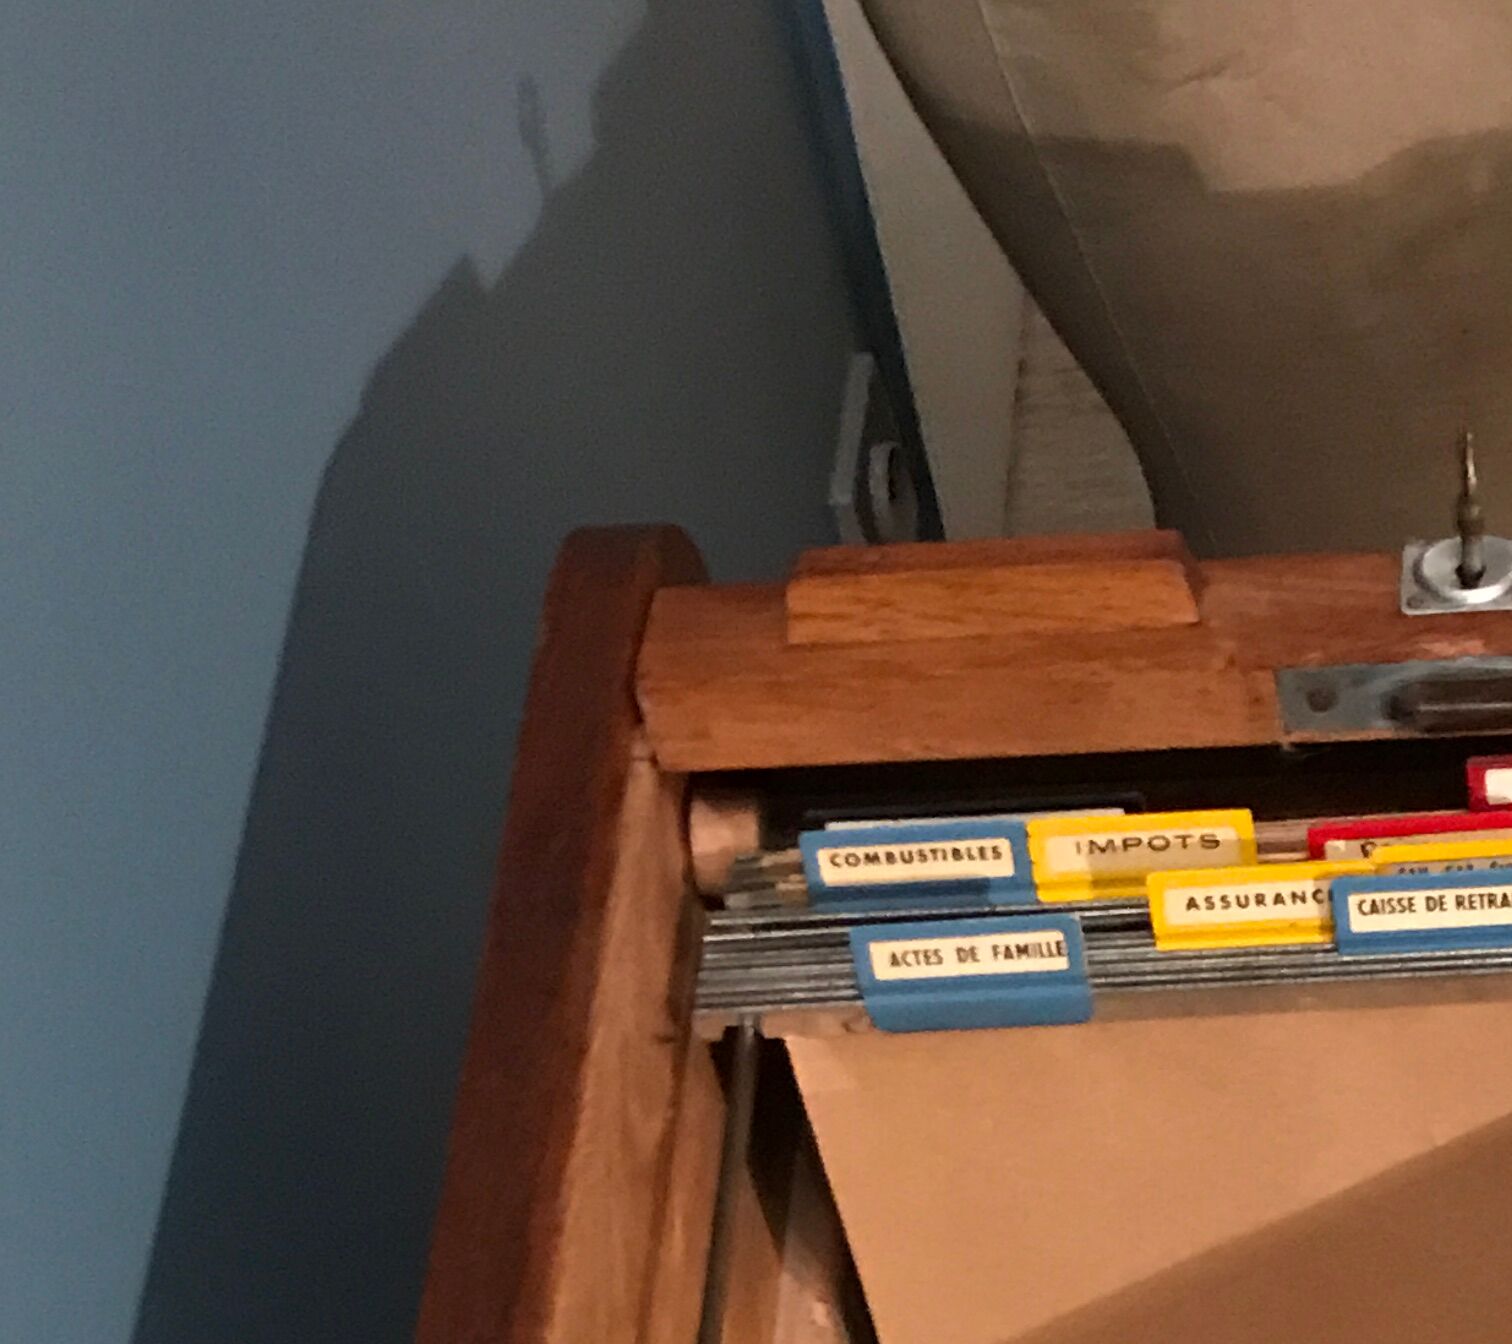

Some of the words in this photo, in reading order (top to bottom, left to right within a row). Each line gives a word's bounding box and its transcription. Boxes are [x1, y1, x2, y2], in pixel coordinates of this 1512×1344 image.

[1075, 833, 1221, 855] IMPOTS
[829, 845, 1004, 868] COMBUSTIBLES
[1186, 887, 1331, 911] ASSURANC
[1357, 896, 1417, 916] CAISSE
[1425, 893, 1449, 912] DE
[890, 949, 944, 968] ACTES
[956, 945, 981, 963] DE
[992, 939, 1068, 960] FAMILLE
